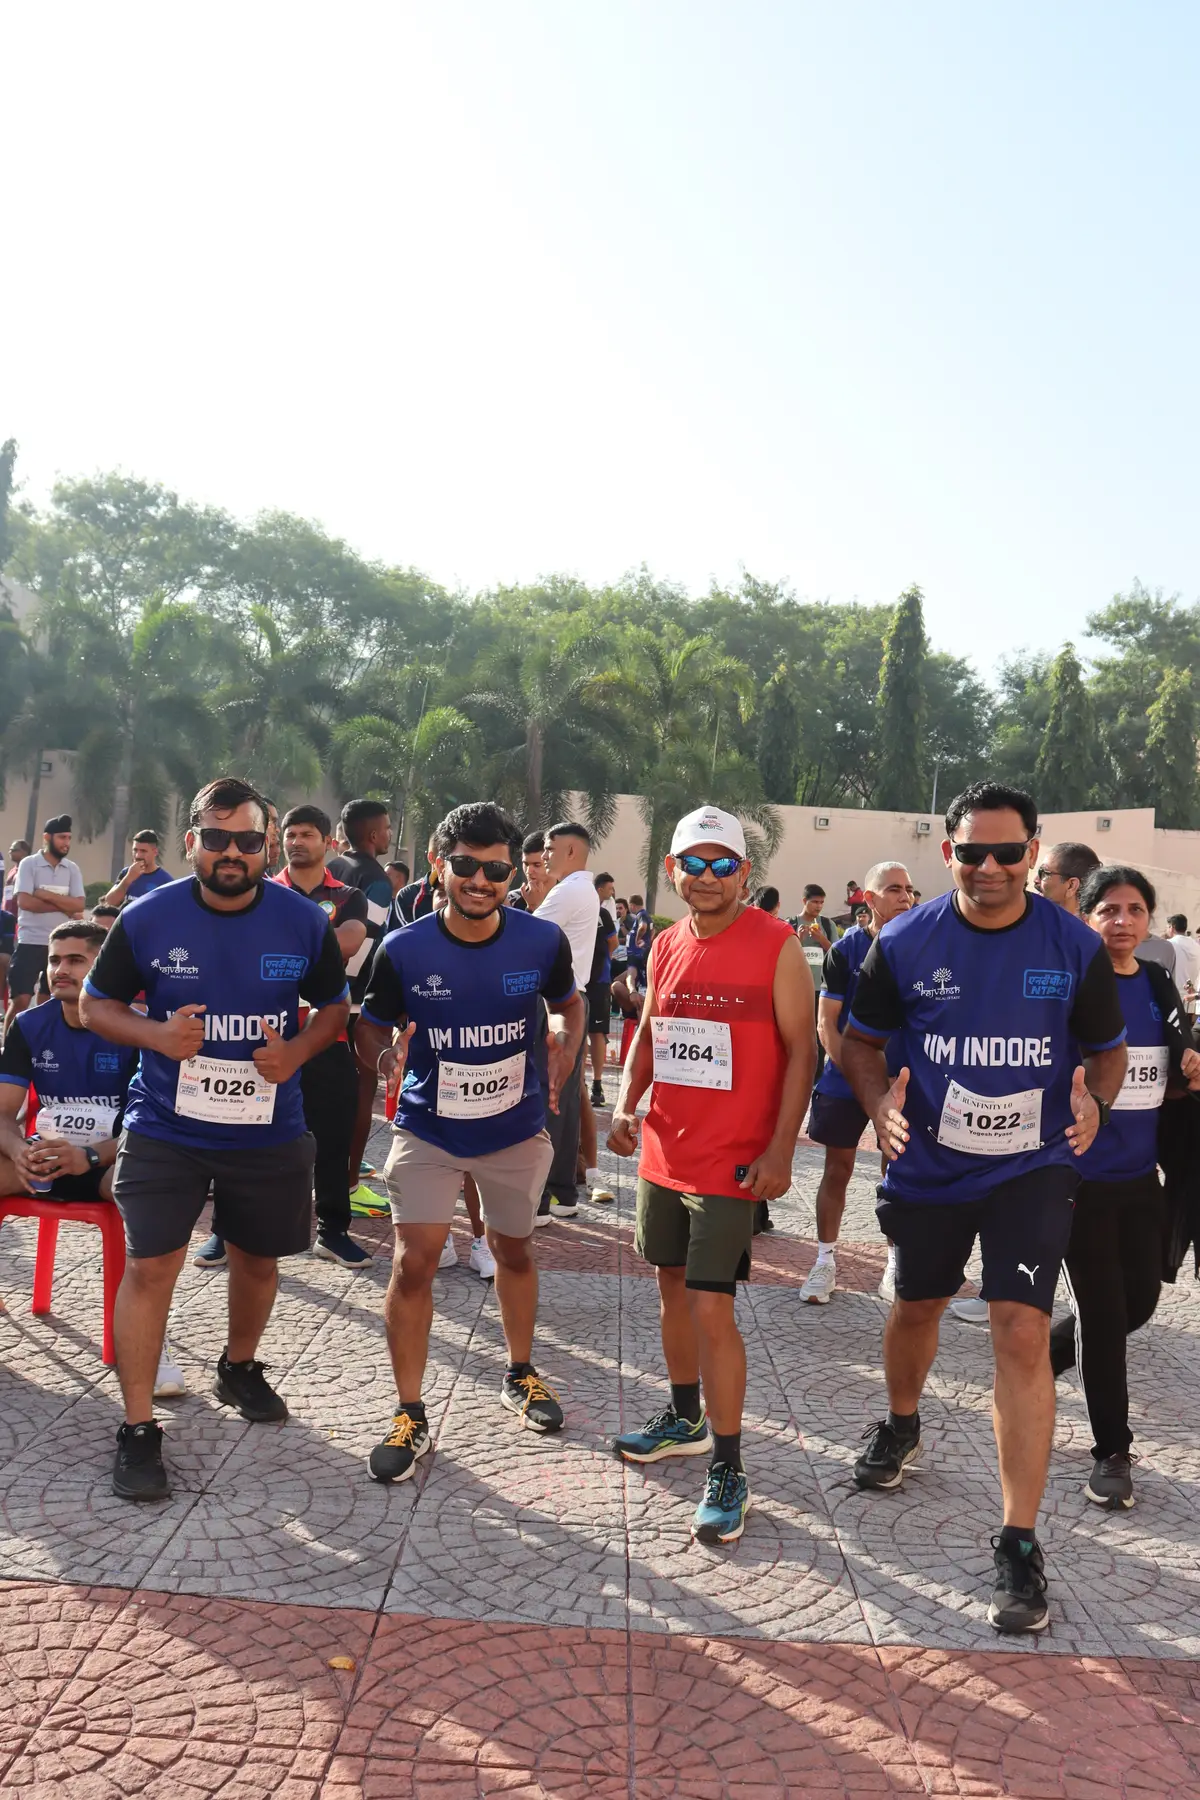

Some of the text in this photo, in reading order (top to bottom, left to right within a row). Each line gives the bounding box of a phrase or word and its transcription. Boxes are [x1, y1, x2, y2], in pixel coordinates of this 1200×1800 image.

[268, 969, 301, 977] NTPC
[511, 983, 536, 993] NTPC
[1031, 986, 1066, 996] NTPC
[427, 1017, 526, 1051] IIM INDORE
[669, 1042, 714, 1063] 1264
[923, 1032, 1053, 1068] IIM INDORE
[199, 1062, 239, 1075] RUNFINITY
[1127, 1066, 1158, 1083] 158
[199, 1076, 256, 1097] 1026
[459, 1075, 509, 1097] 1002
[208, 1095, 229, 1104] Ayush
[962, 1096, 1002, 1111] RUNFINITY
[53, 1114, 96, 1131] 1209
[963, 1111, 1021, 1131] 1022
[968, 1129, 993, 1138] Yogesh
